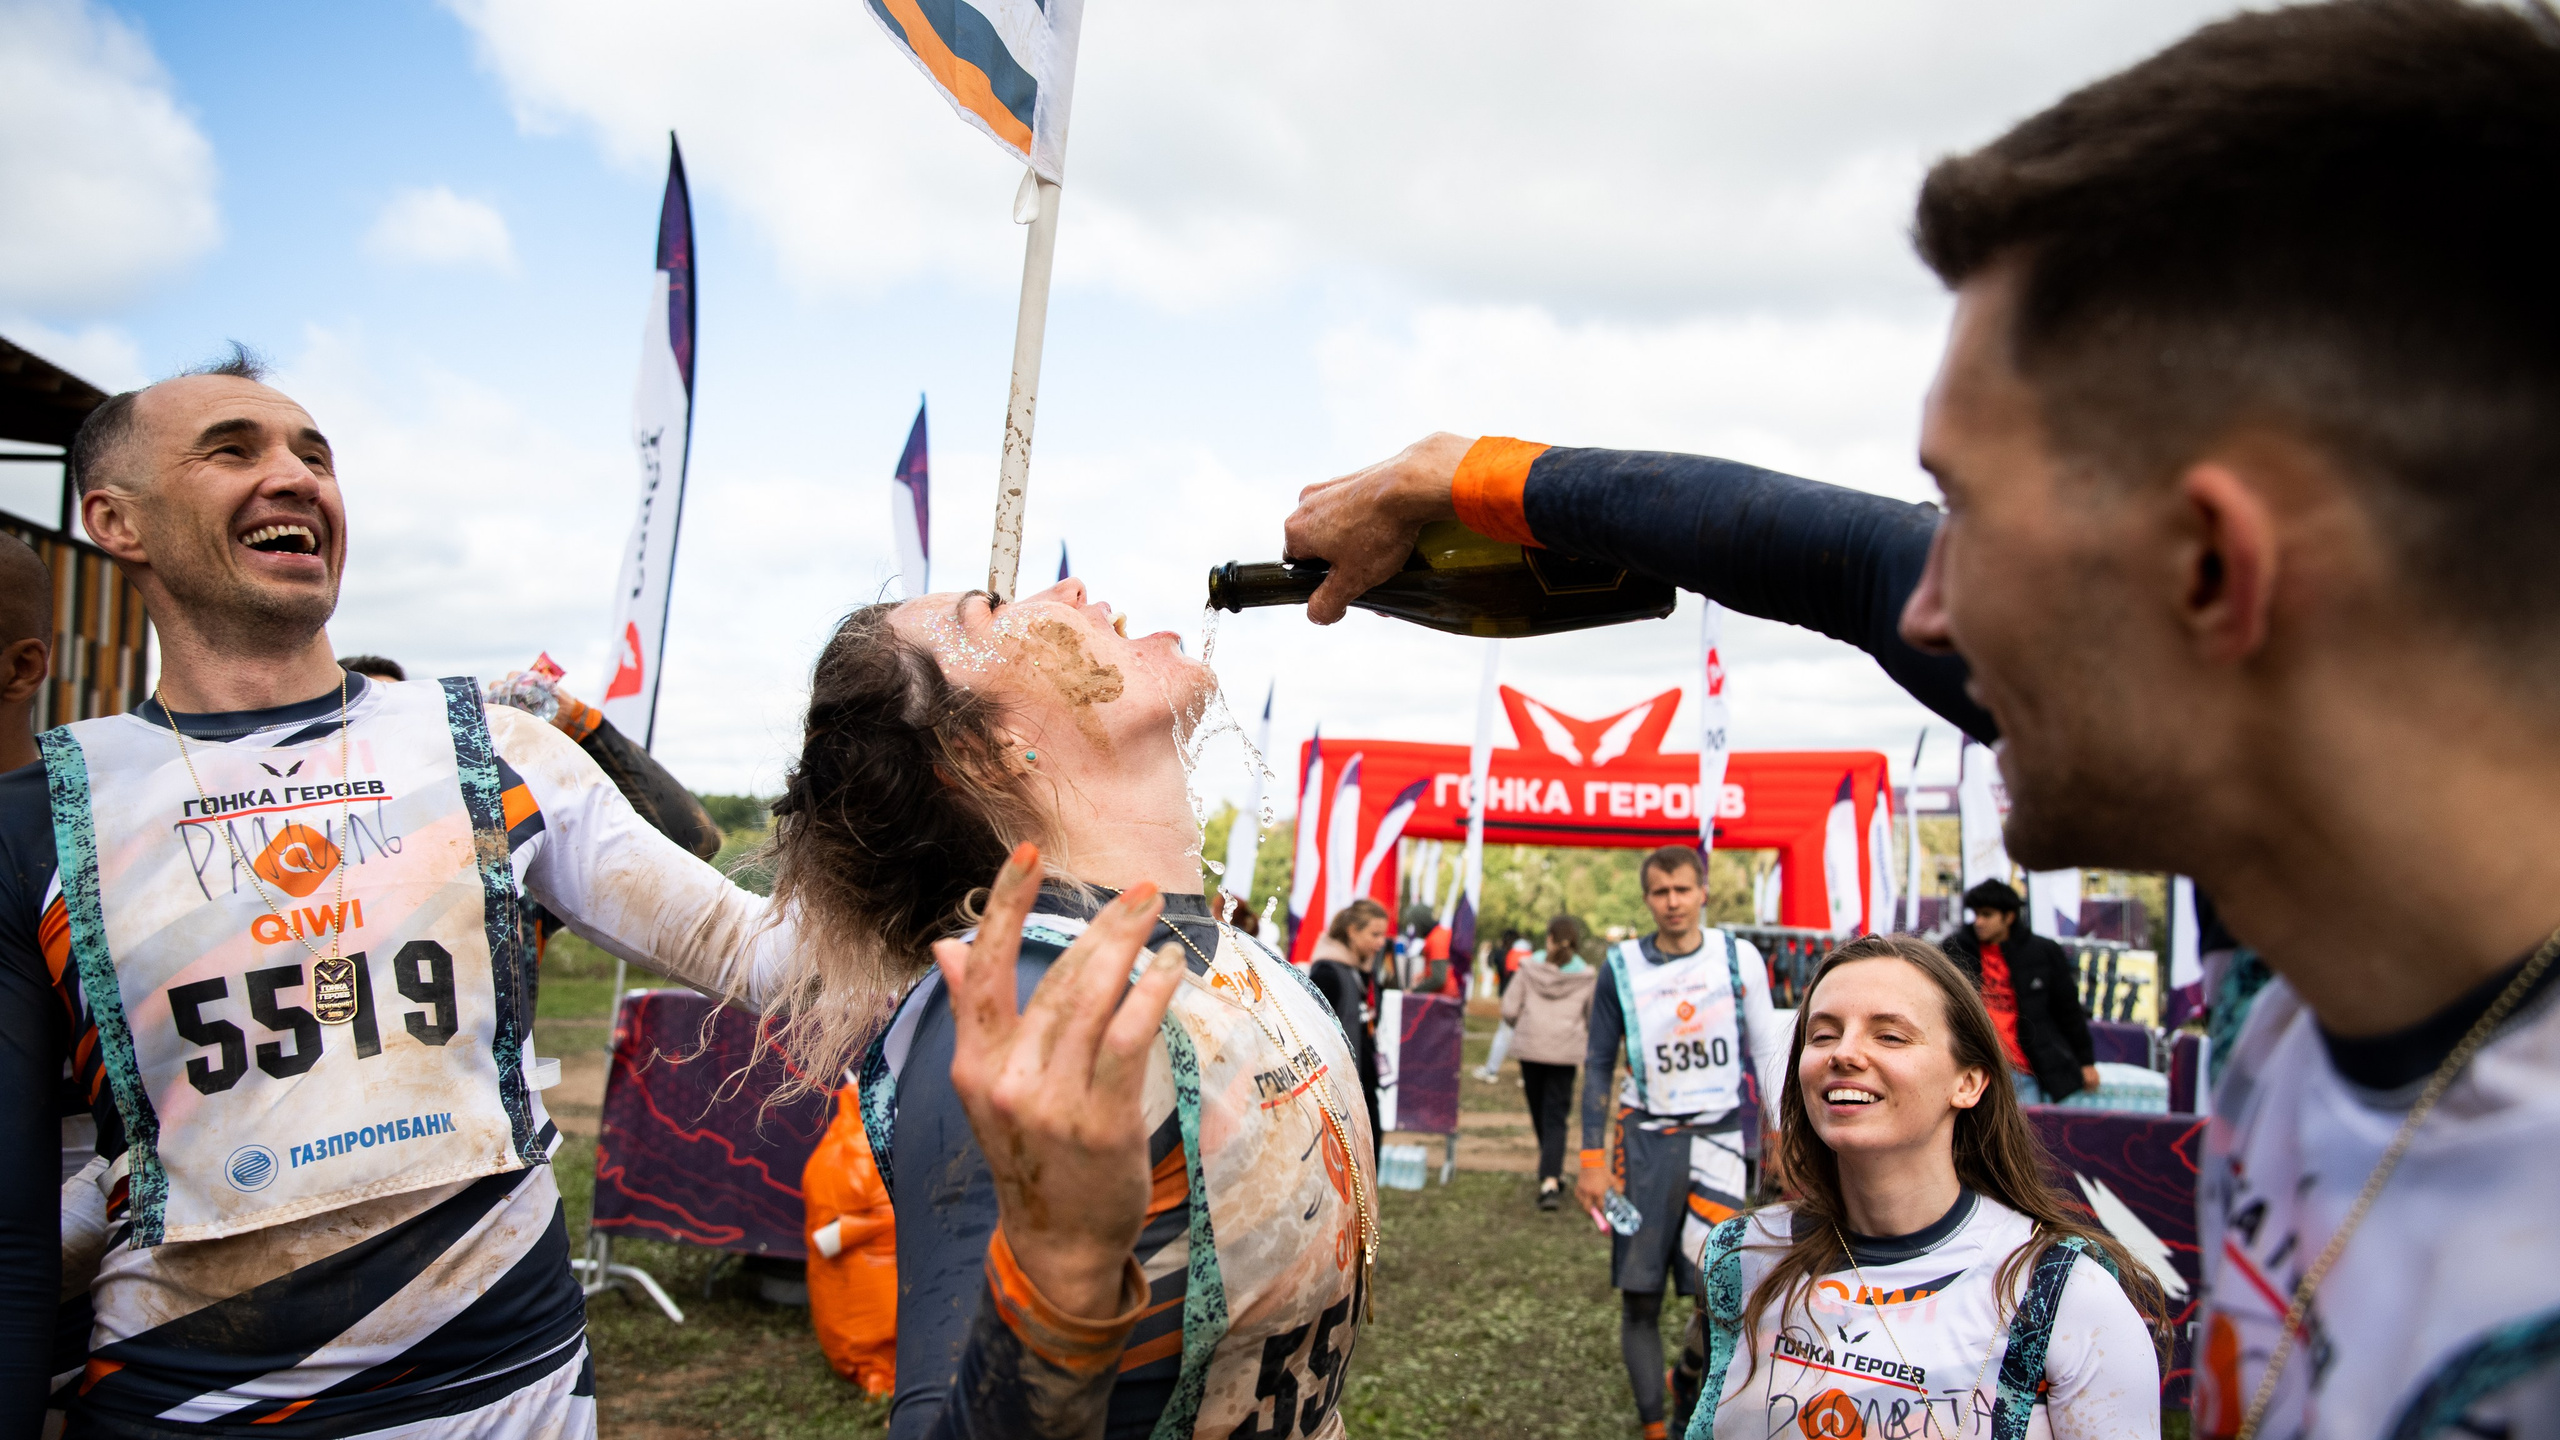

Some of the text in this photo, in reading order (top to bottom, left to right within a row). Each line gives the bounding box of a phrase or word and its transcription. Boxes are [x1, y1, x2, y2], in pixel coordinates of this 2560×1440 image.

[183, 779, 386, 818] ГОНКА ГЕРОЕВ
[250, 898, 365, 946] QIWI
[167, 939, 459, 1096] 5519
[289, 1112, 457, 1169] ГАЗПРОМБАНК
[1775, 1334, 1926, 1386] ГОНКА ГЕРОЕВ
